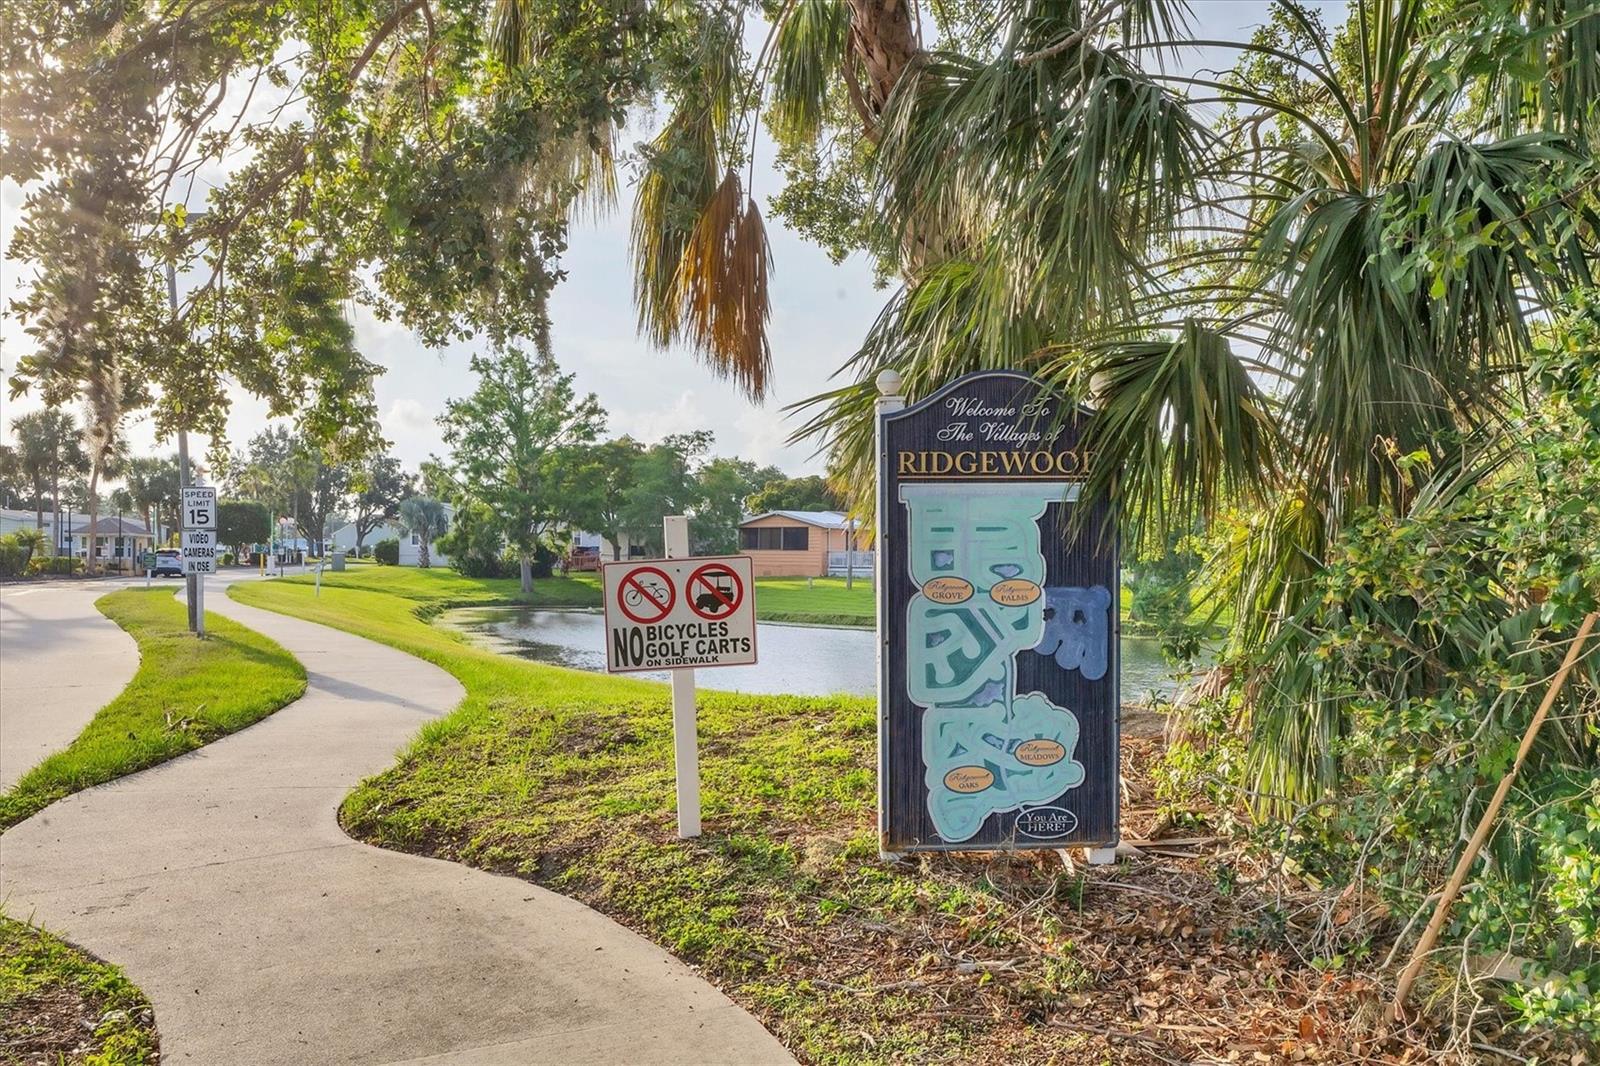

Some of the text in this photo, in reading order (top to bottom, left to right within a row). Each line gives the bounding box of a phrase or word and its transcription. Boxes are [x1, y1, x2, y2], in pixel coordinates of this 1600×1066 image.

[945, 397, 1052, 417] Welcome To
[936, 422, 974, 442] The
[979, 422, 1041, 449] Villages
[184, 490, 214, 498] SPEED
[189, 509, 210, 525] 15
[188, 533, 209, 544] VIDEO
[183, 547, 215, 558] CAMERAS
[188, 561, 195, 572] IN
[931, 591, 963, 600] GROVE
[1001, 594, 1029, 602] PALMS
[613, 621, 729, 668] NO BICYCLES
[645, 637, 751, 659] GOLF CARTS
[646, 655, 720, 667] ON SIDEWALK
[1020, 753, 1061, 761] MEADOWS
[958, 782, 980, 790] OAKS
[1026, 812, 1068, 822] You Are
[1027, 823, 1066, 832] HERE!
